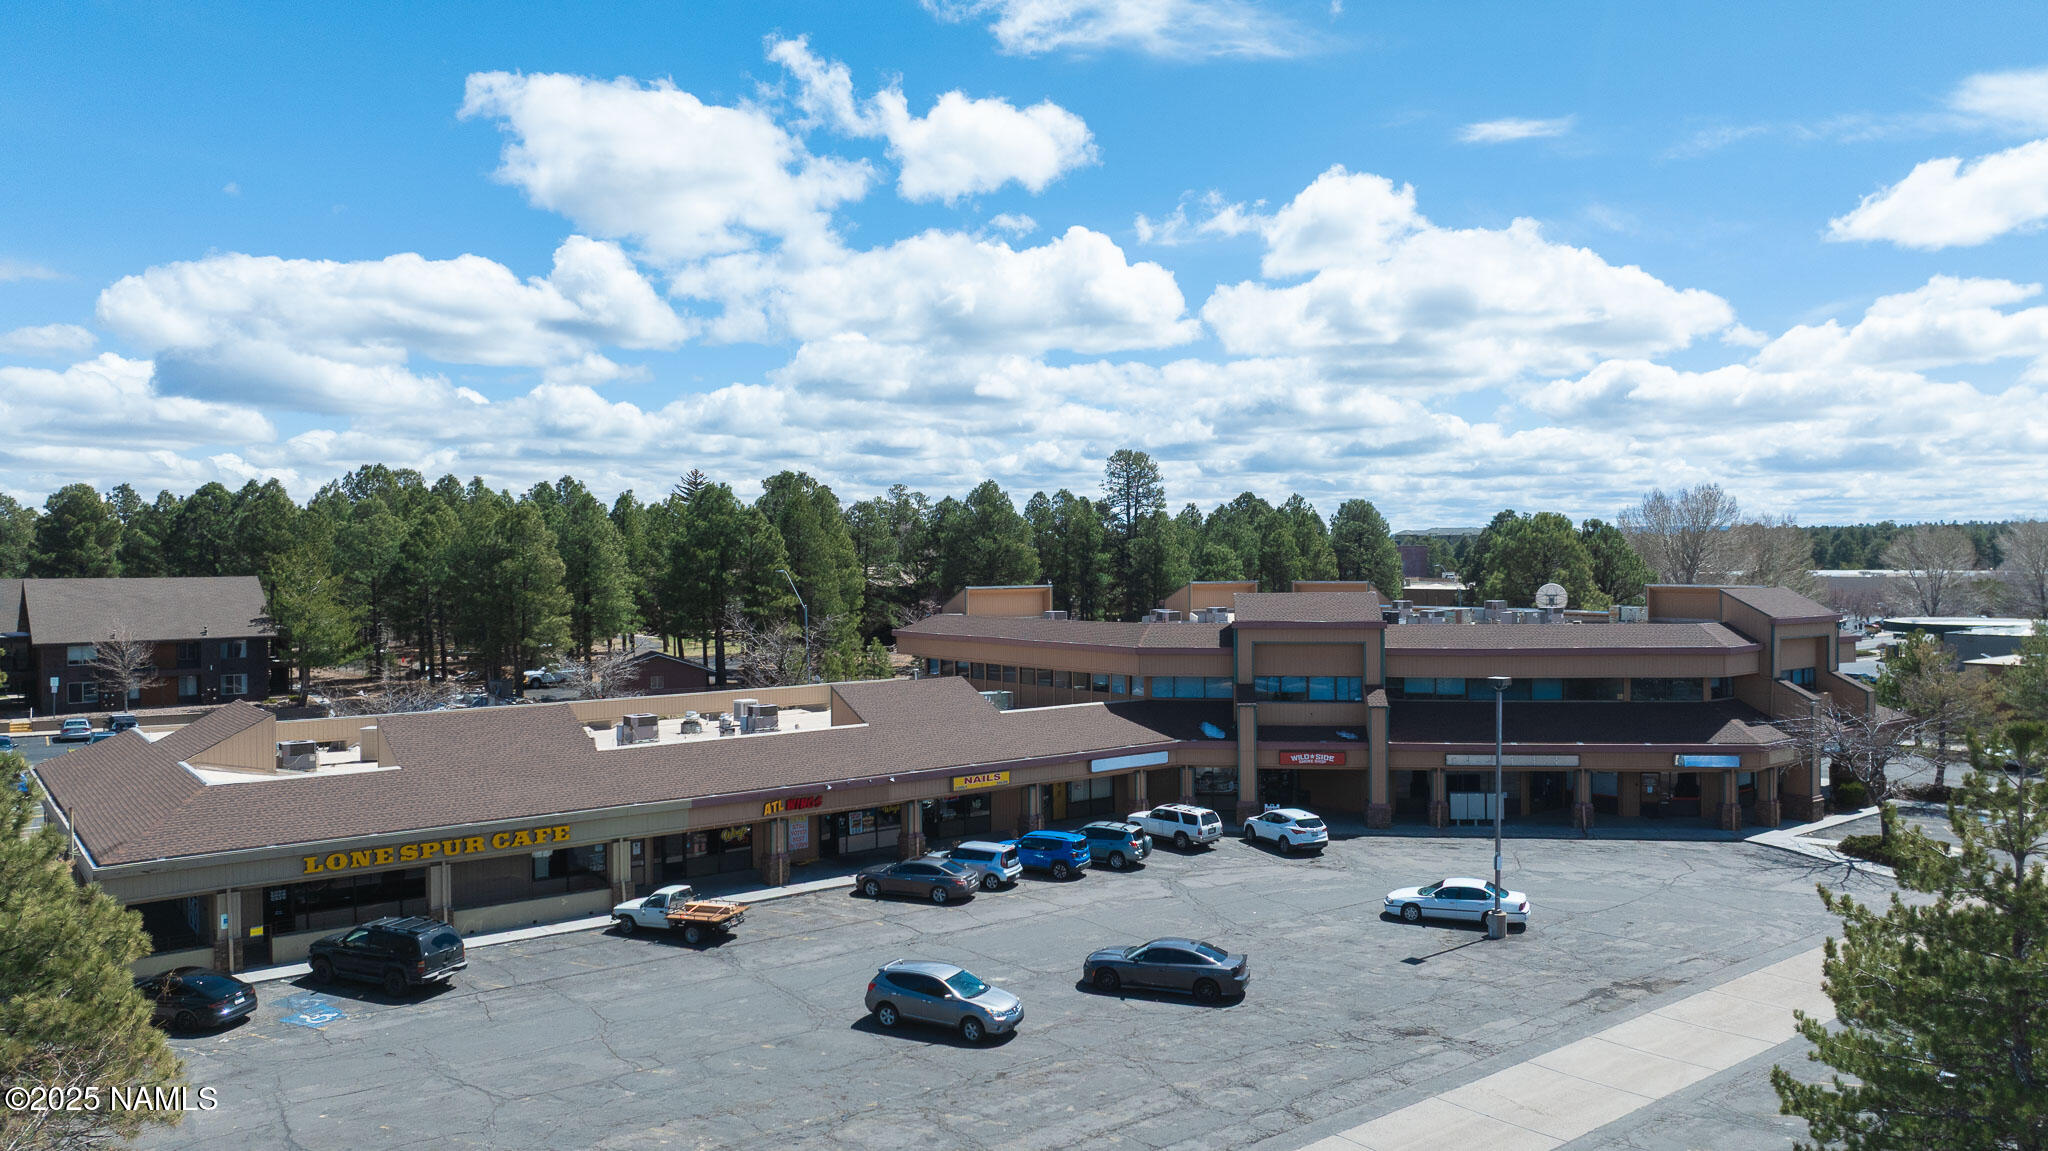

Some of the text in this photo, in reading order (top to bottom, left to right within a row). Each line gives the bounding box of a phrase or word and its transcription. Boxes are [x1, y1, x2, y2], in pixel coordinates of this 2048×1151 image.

[1290, 753, 1335, 762] WILD SIDE
[964, 773, 1001, 785] NAILS
[763, 795, 824, 816] ATL WINGS
[303, 825, 572, 874] LONE SPUR CAFE
